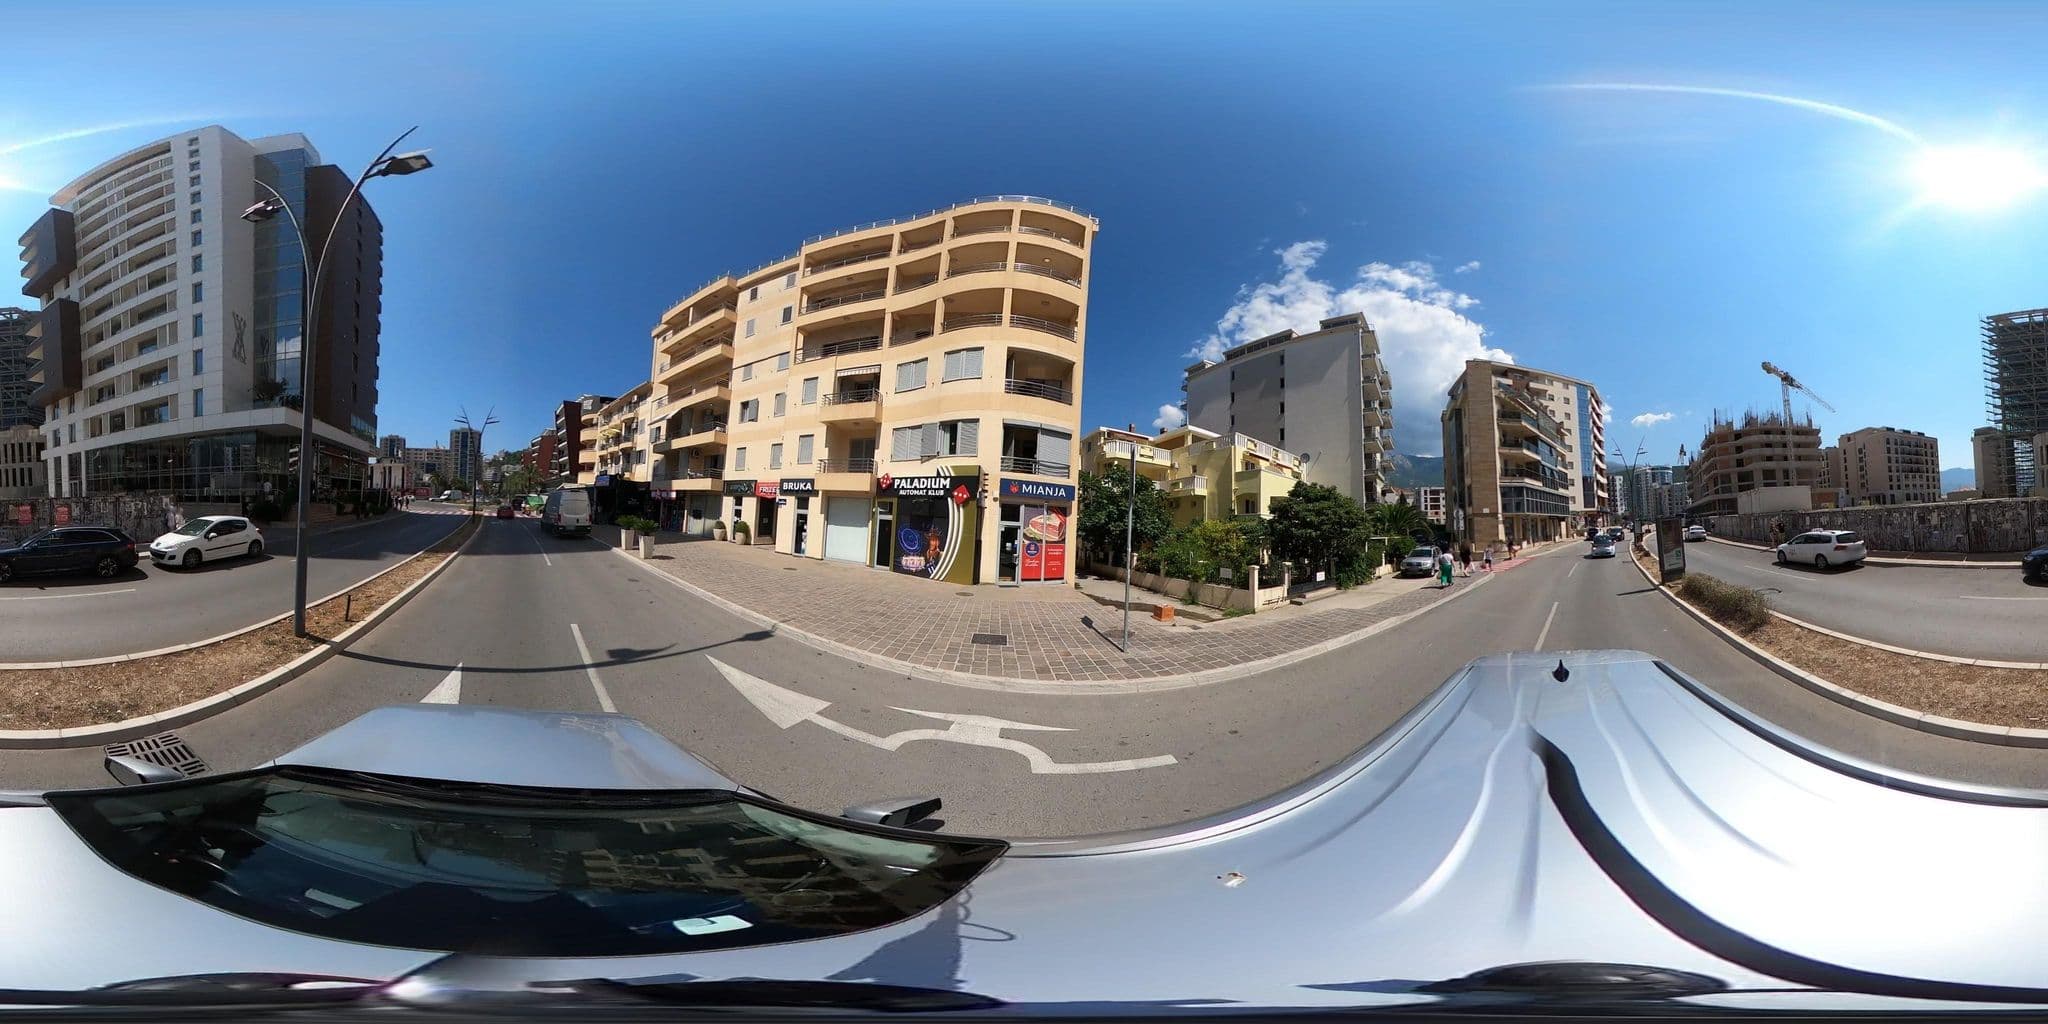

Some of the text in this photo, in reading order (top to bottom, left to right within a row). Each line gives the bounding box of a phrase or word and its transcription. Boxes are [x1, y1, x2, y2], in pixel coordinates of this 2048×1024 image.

[782, 482, 812, 491] BRUKA
[894, 478, 951, 489] PALADIUM
[1022, 484, 1066, 497] MIANJA
